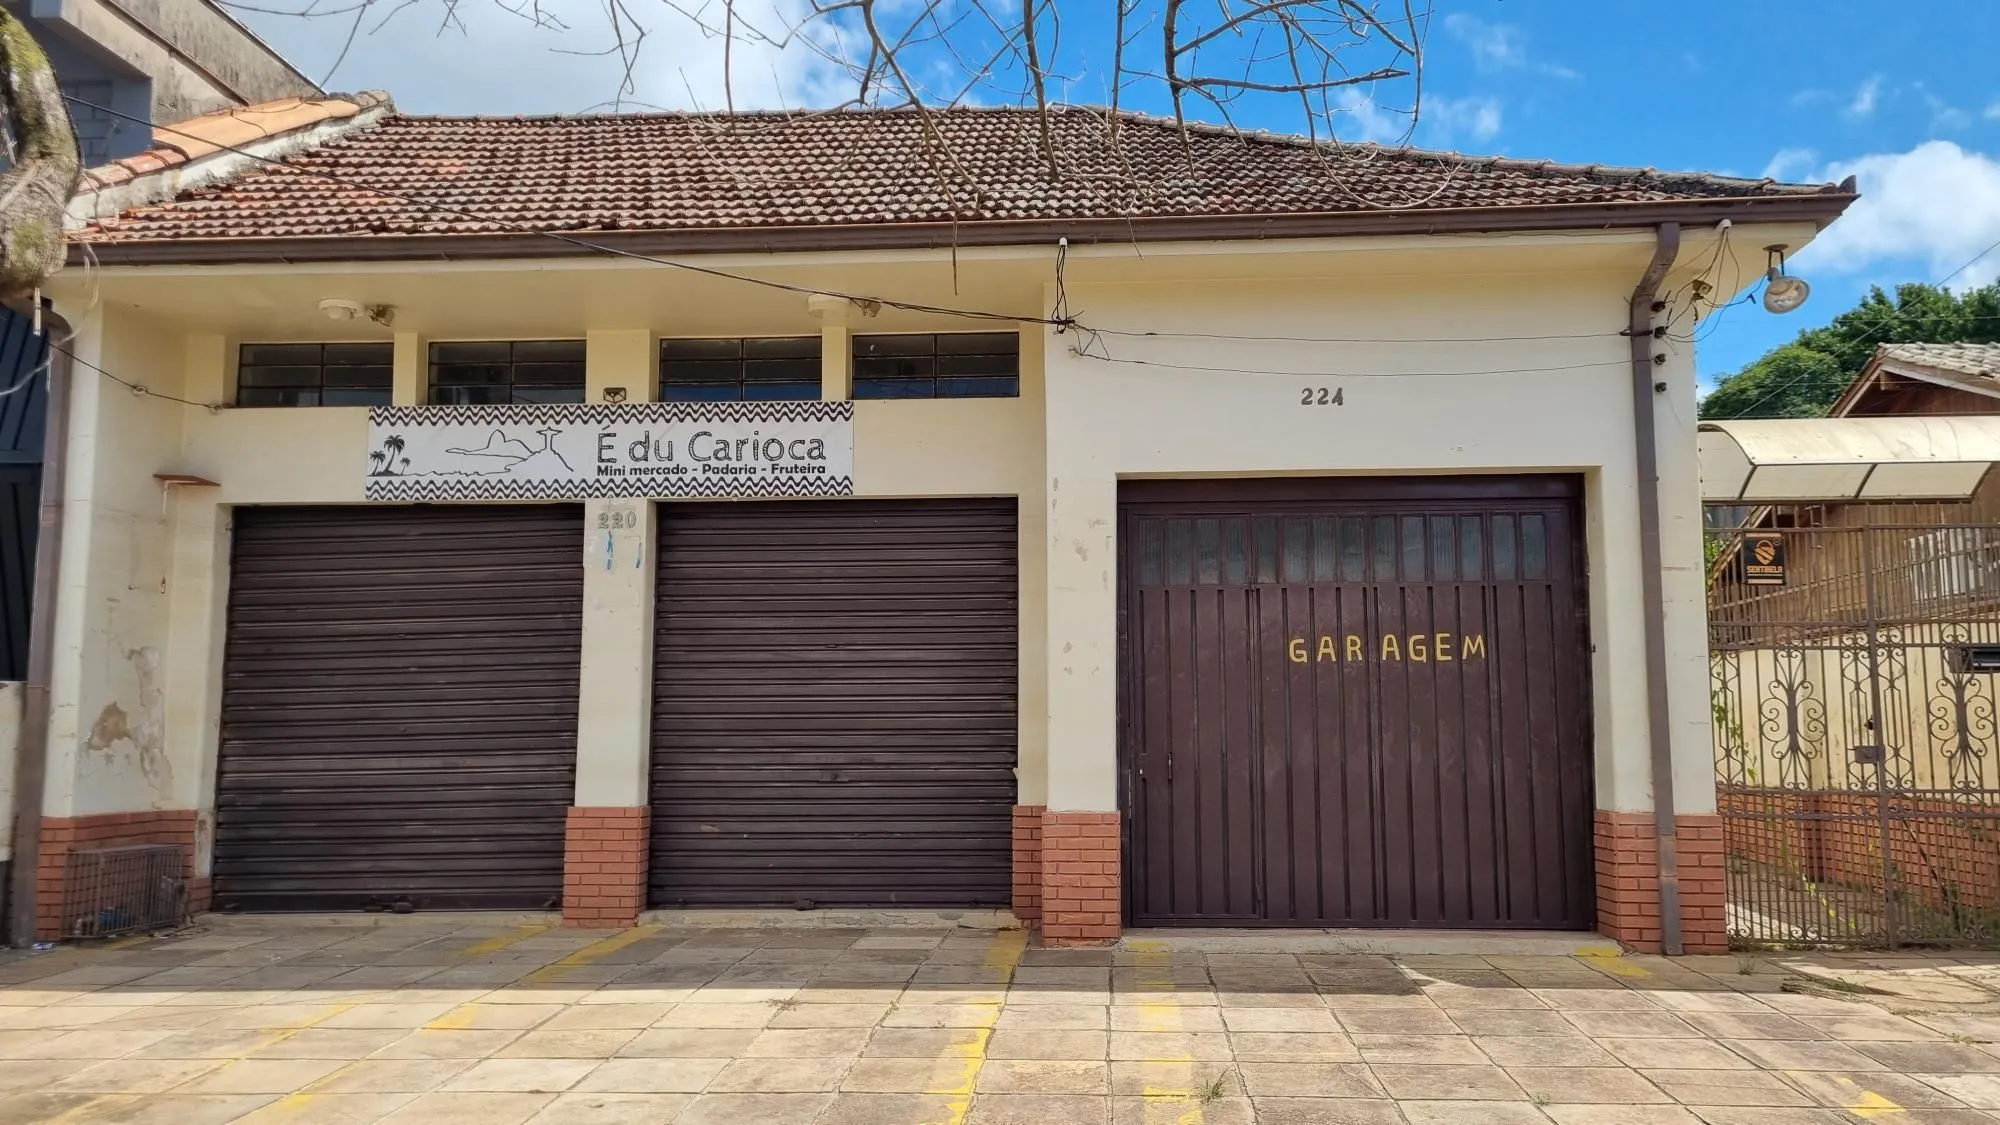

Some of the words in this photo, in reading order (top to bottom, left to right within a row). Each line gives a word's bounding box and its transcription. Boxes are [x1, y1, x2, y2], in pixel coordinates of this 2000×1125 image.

[1301, 387, 1344, 406] 224
[597, 424, 617, 463] É
[628, 430, 673, 462] du
[688, 430, 827, 462] Carioca
[597, 465, 626, 476] Mini
[629, 464, 688, 476] mercado
[702, 463, 757, 475] Padaria
[771, 463, 826, 475] Fruteira
[598, 510, 637, 529] 220
[1289, 633, 1486, 664] GARAGEM
